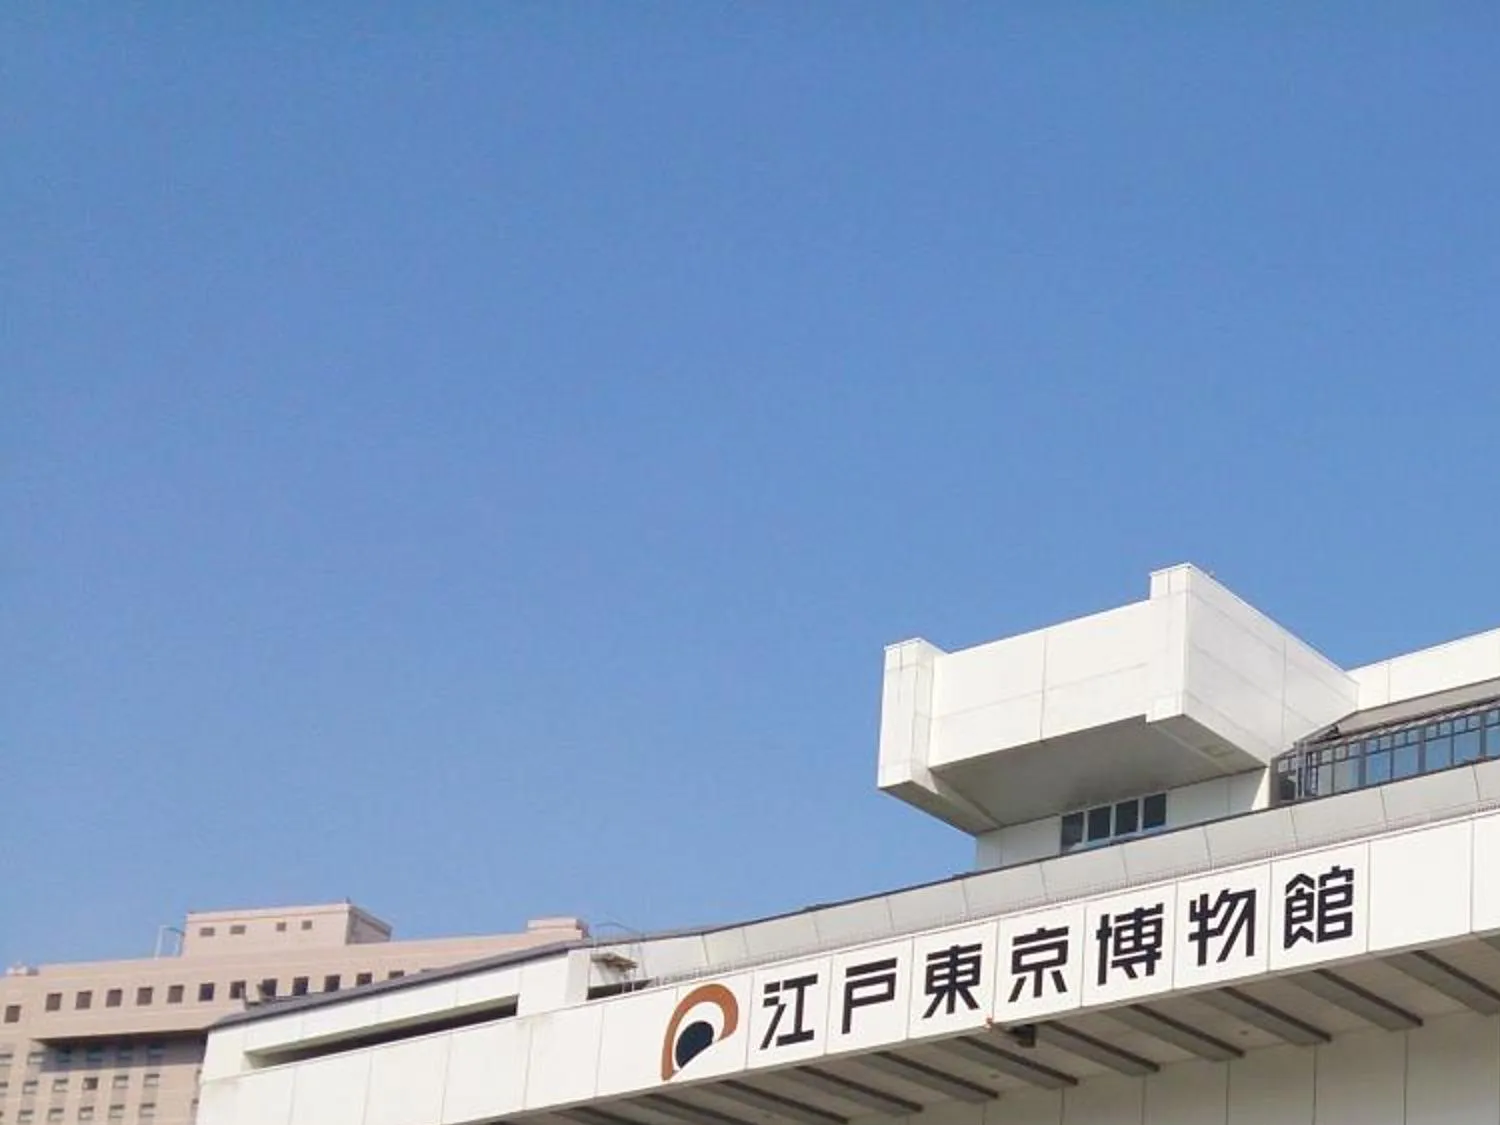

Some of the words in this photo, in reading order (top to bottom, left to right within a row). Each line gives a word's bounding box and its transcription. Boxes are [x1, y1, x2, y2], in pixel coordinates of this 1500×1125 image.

[760, 865, 1354, 1050] 江戸東京博物館
